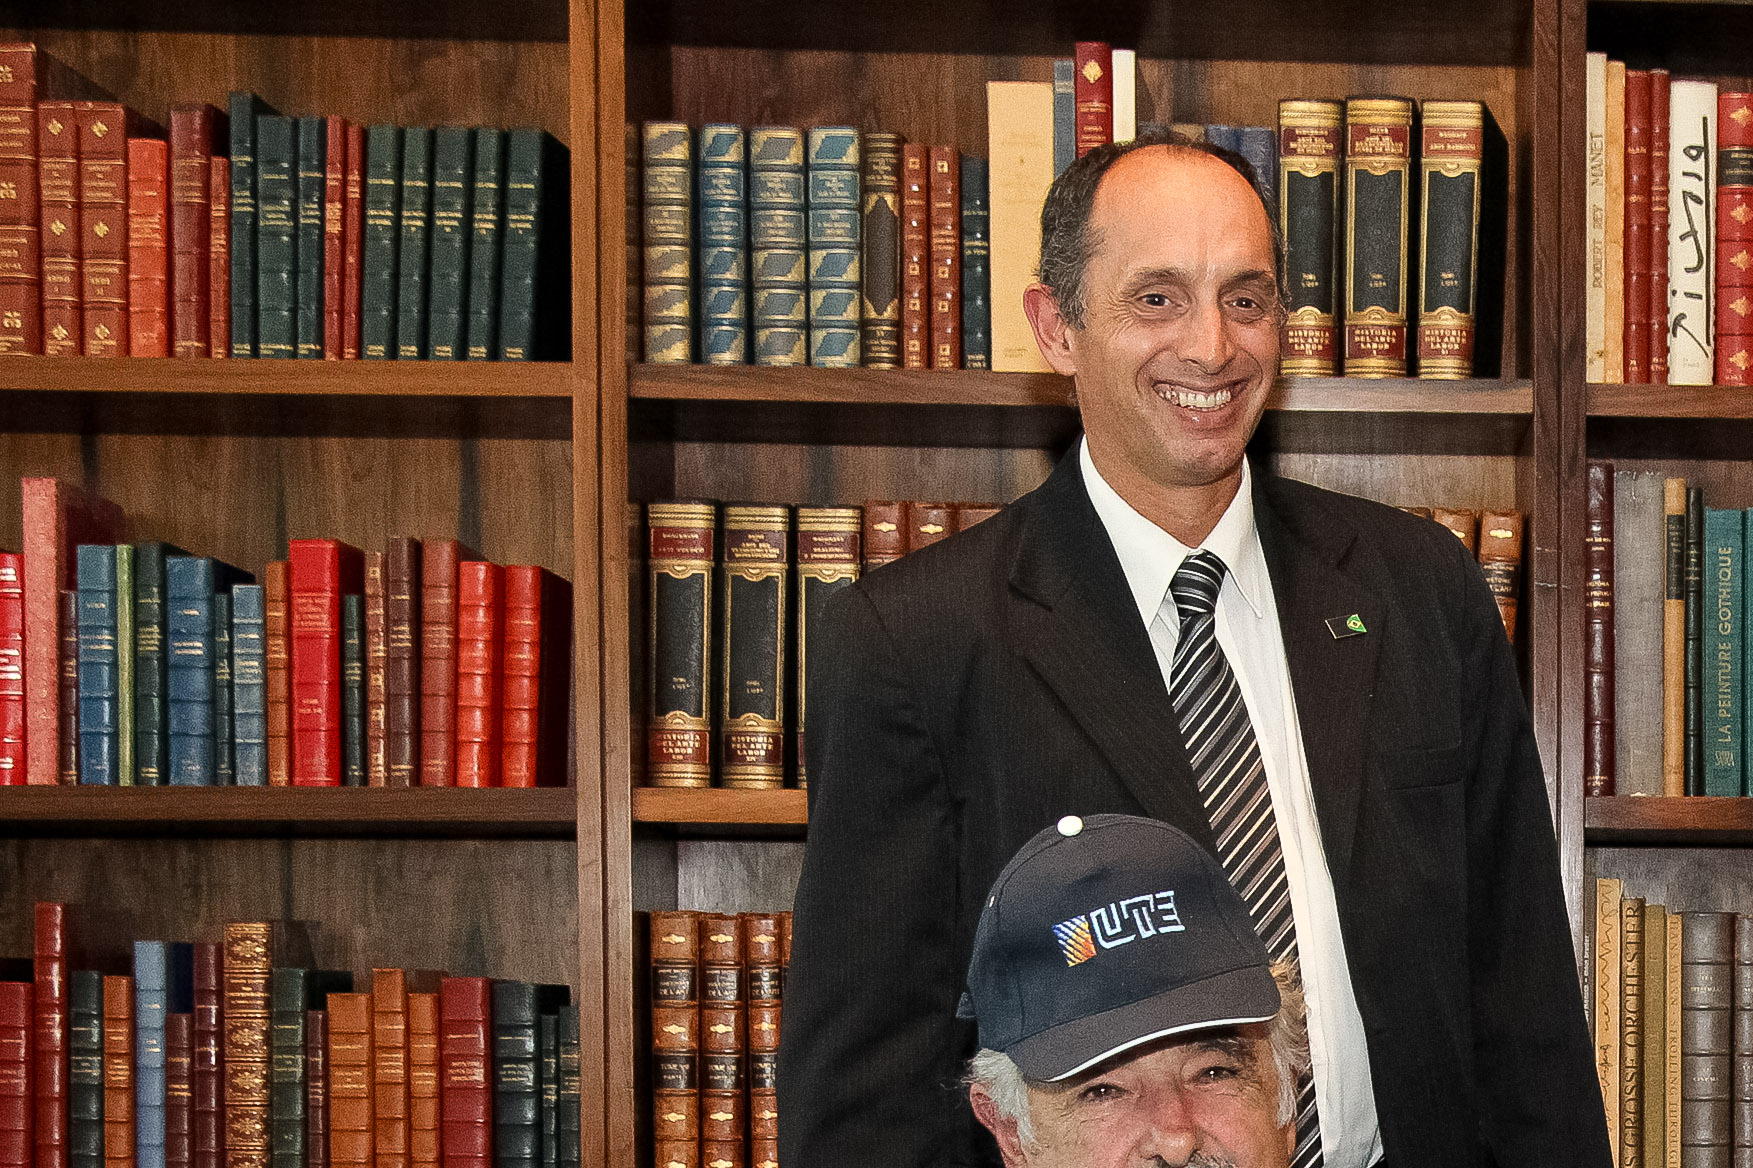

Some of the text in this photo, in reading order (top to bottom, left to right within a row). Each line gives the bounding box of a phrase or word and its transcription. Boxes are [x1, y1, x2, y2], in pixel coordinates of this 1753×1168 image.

[1590, 132, 1603, 288] ROBERT REY MANET
[1718, 547, 1732, 742] LA PEINTURE GOTHIQUE
[1090, 890, 1186, 949] UTE
[1669, 920, 1680, 959] HANS
[1623, 905, 1642, 1047] ORCHESTER
[1669, 965, 1680, 1006] MANN
[1669, 1020, 1680, 1095] STROLLING
[1623, 1057, 1641, 1148] GROSSE
